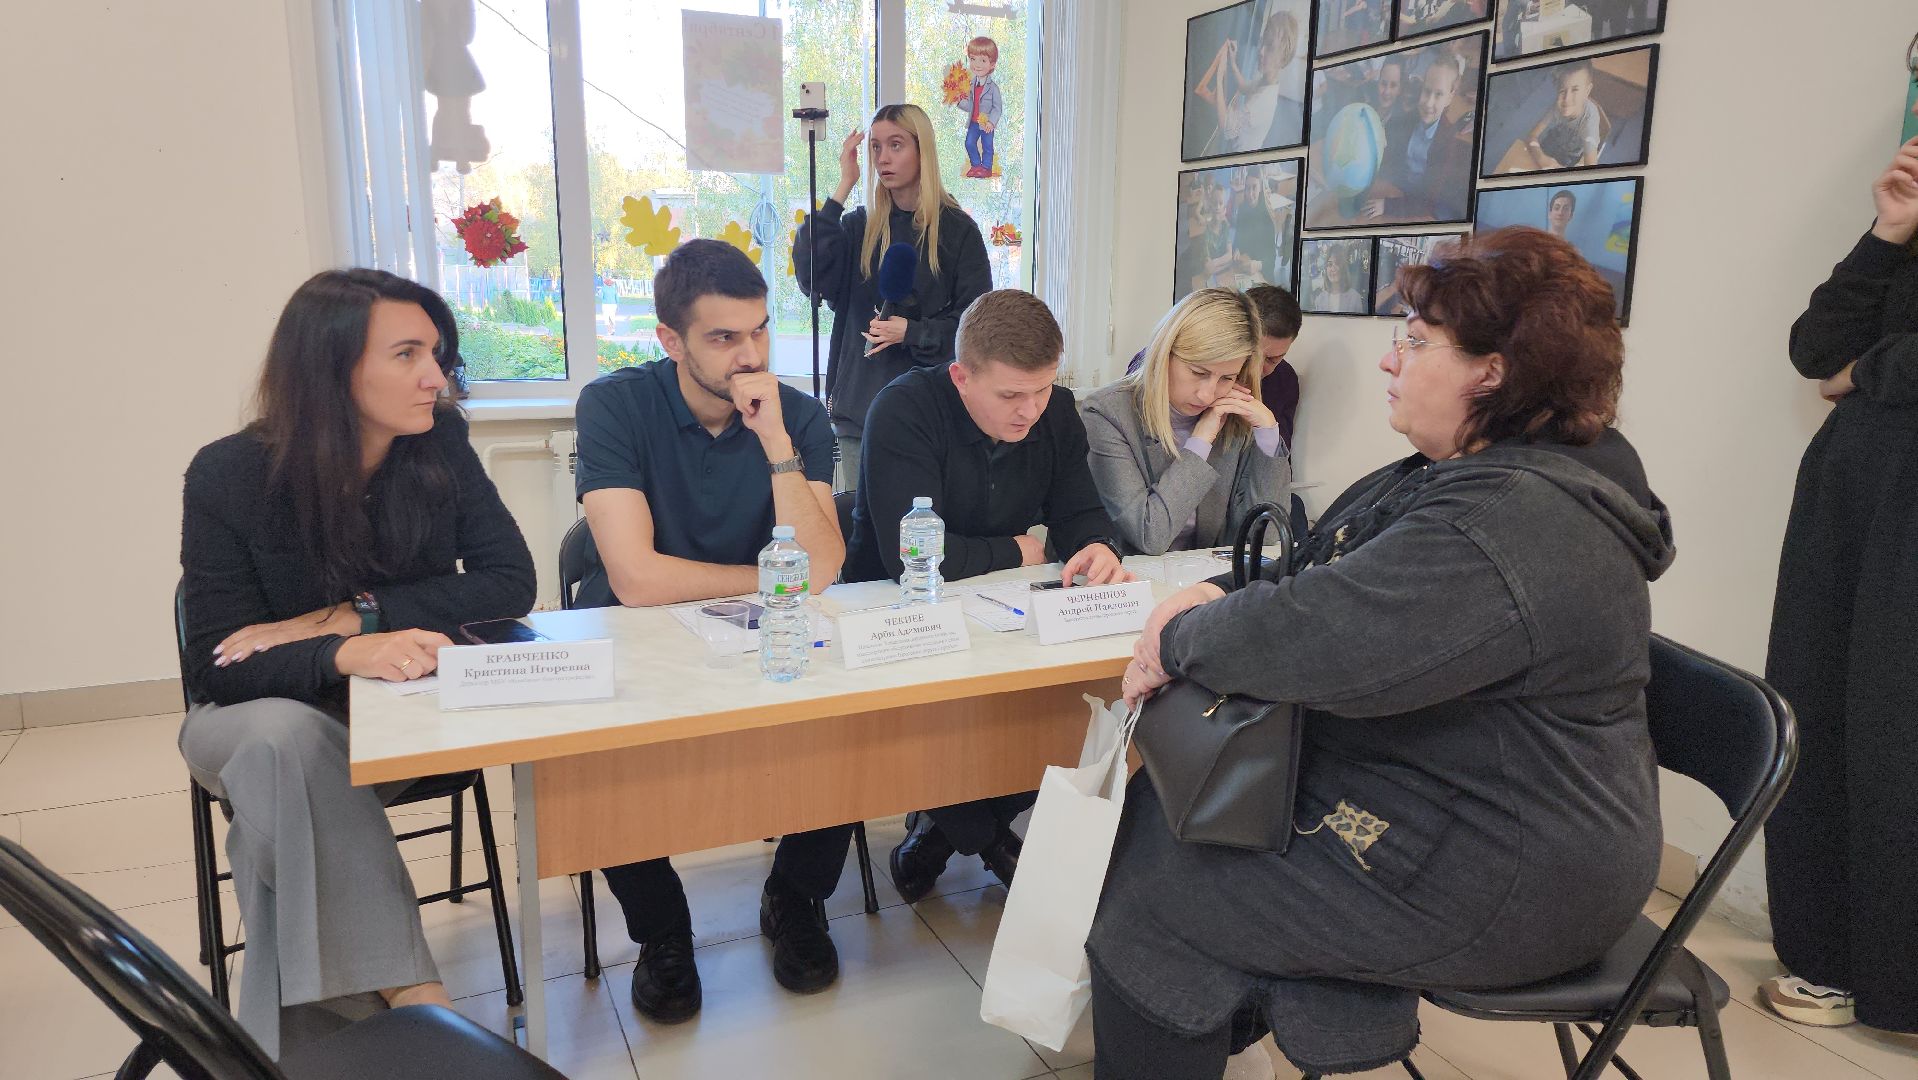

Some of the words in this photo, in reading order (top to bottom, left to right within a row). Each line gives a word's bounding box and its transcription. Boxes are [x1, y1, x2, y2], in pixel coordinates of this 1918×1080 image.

[1066, 589, 1127, 604] ЧЕРНЫШОВ
[1058, 604, 1093, 616] Андрей
[1094, 600, 1140, 612] Павлович
[884, 613, 925, 627] ЧЕКИЕВ
[870, 630, 896, 641] Арби
[897, 623, 942, 636] Адамович
[486, 650, 569, 664] КРАВЧЕНКО
[464, 667, 527, 680] Кристина
[530, 663, 591, 676] Игоревна
